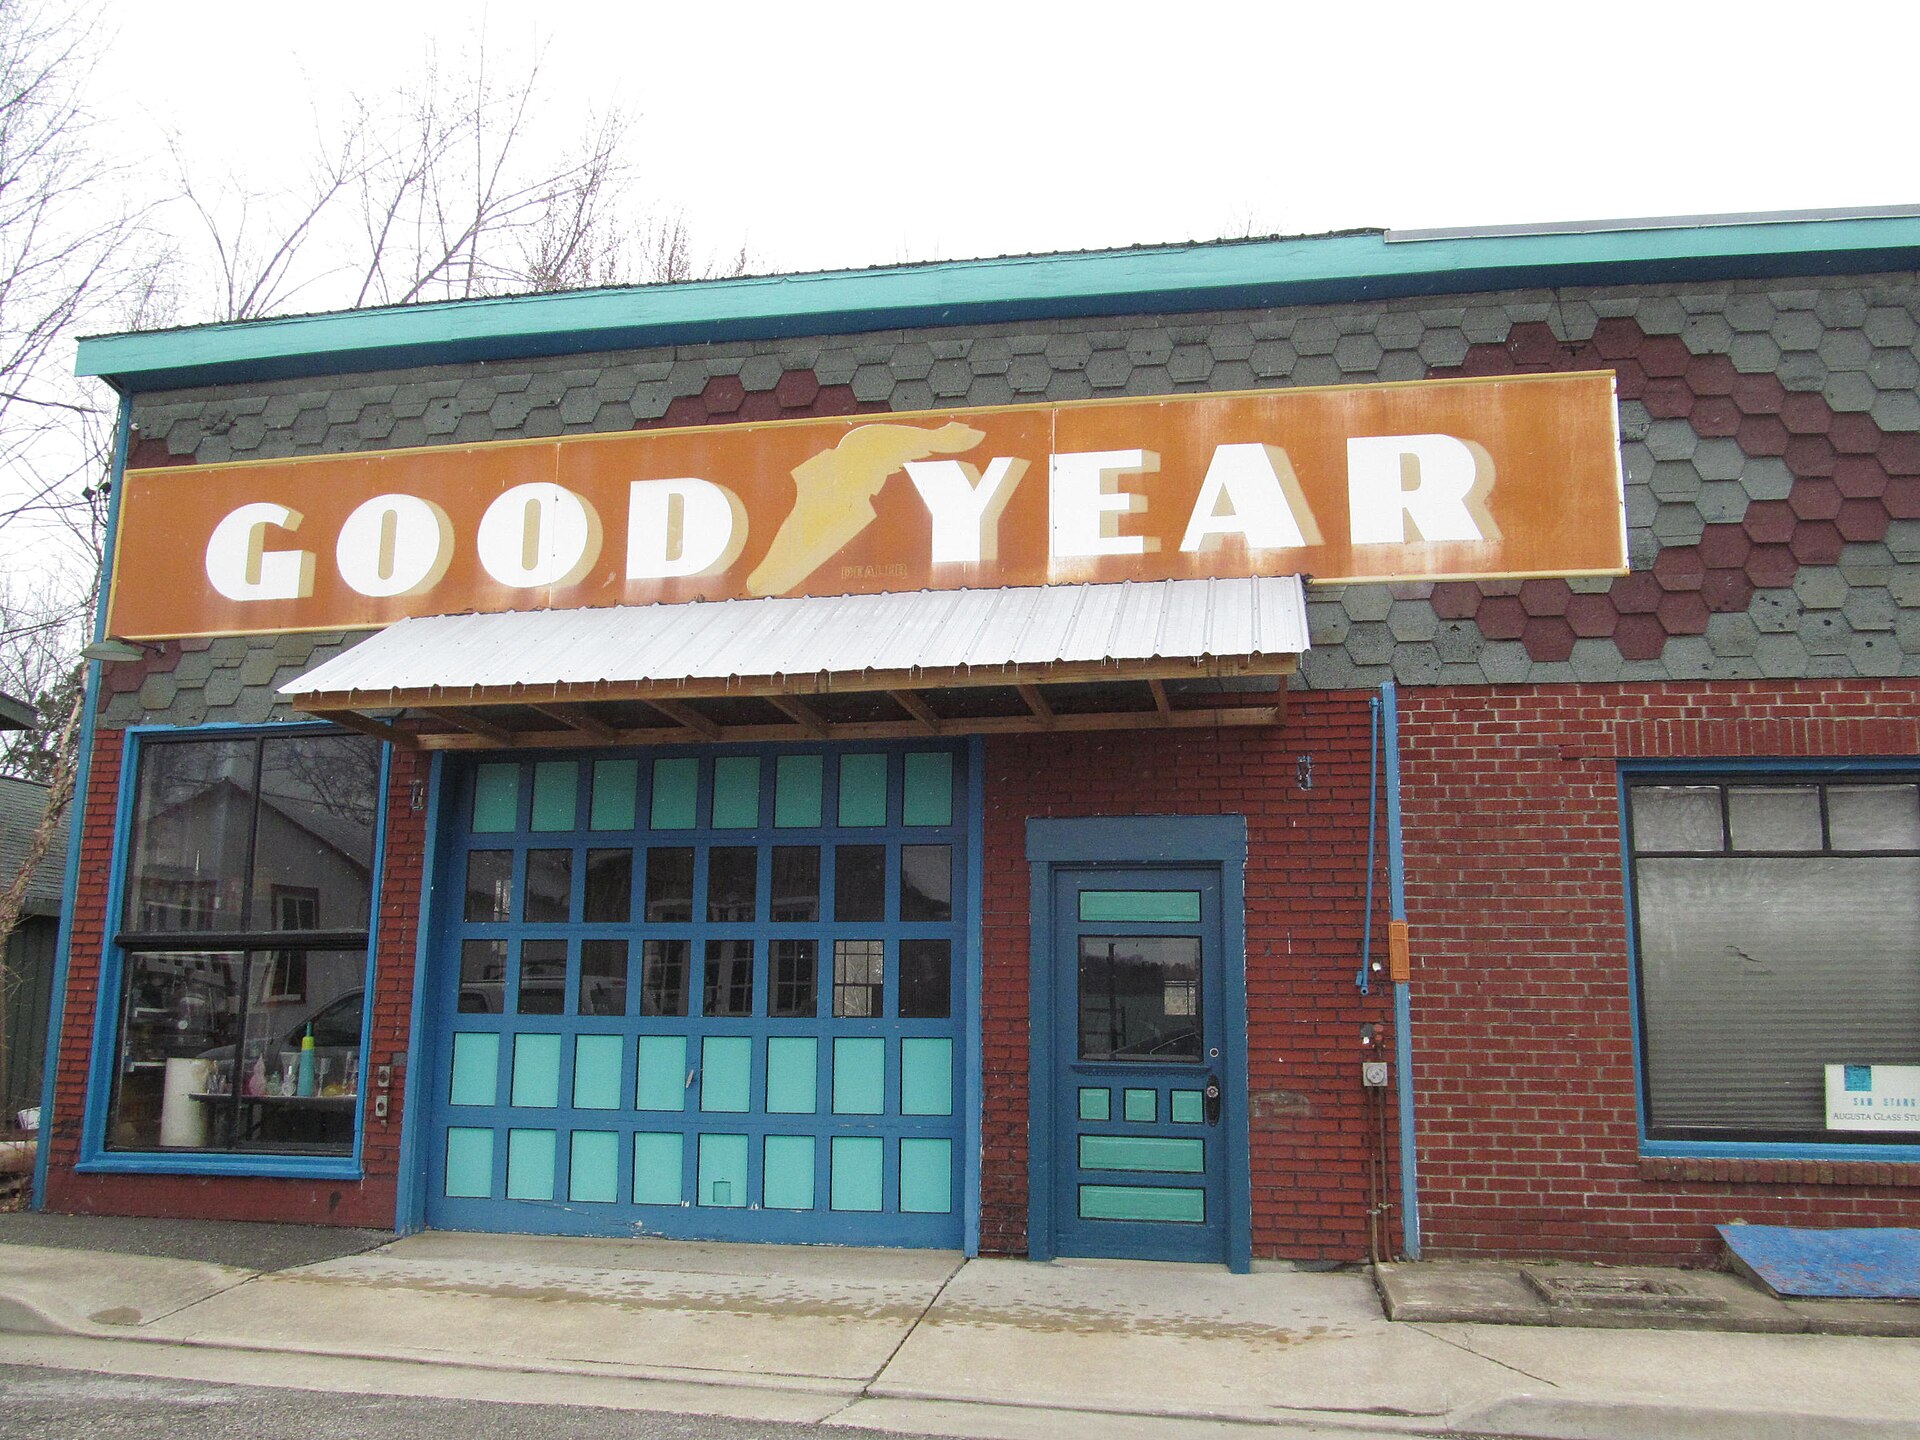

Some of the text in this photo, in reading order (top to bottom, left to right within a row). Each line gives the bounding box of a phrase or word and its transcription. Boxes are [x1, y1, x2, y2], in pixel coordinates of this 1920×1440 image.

[205, 433, 1502, 601] GOOD YEAR
[1833, 1112, 1871, 1121] AUGUSTA
[1873, 1112, 1902, 1122] GLASS
